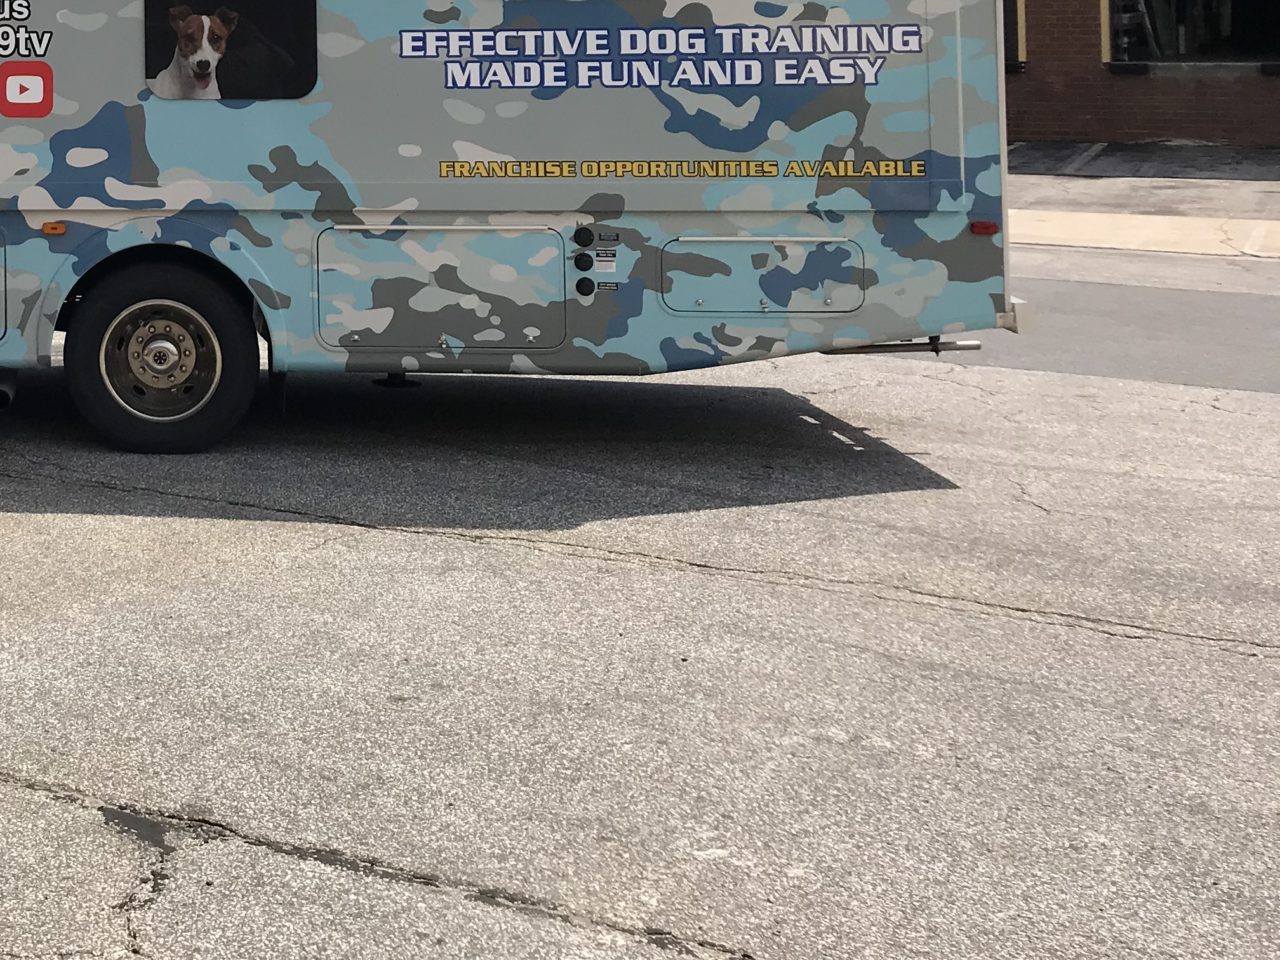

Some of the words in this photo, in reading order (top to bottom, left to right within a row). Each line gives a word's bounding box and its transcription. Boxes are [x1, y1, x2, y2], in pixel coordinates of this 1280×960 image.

[399, 27, 612, 58] EFFECTIVE
[618, 26, 707, 57] DOG
[714, 24, 922, 55] TRAINING
[444, 59, 568, 90] MADE
[576, 58, 661, 89] FUN
[671, 57, 763, 88] AND
[773, 56, 887, 86] EASY
[439, 161, 577, 178] FRANCHISE
[581, 160, 778, 178] OPPORTUNITIES
[783, 159, 926, 177] AVAILABLE
